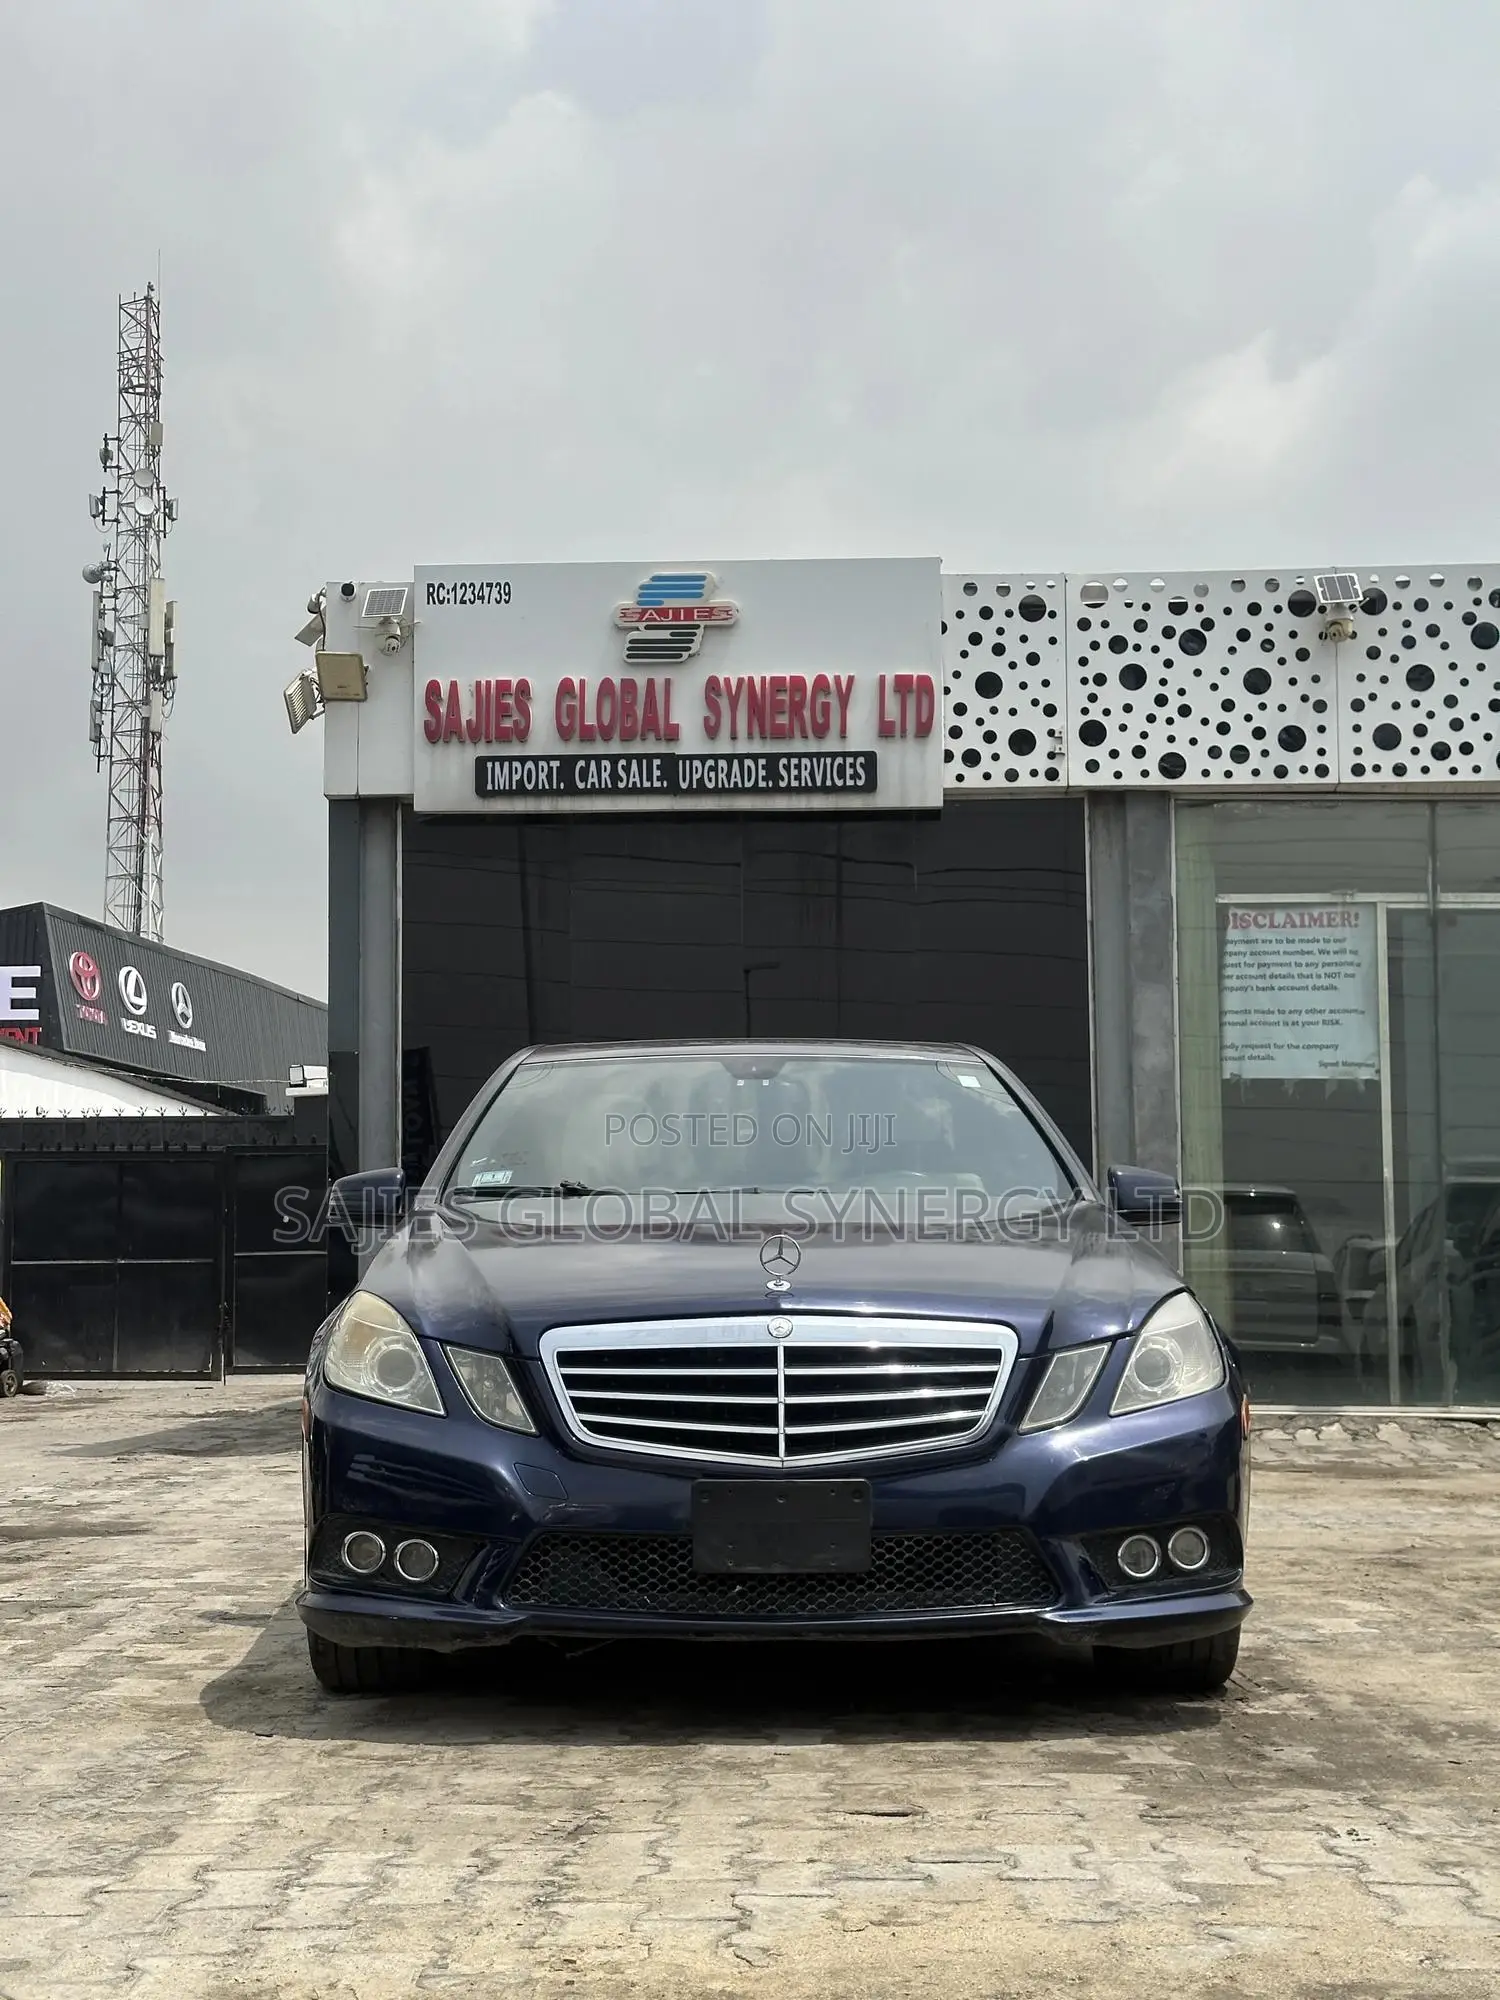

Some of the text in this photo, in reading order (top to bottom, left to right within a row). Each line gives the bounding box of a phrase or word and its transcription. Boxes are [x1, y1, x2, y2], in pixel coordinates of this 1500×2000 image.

[426, 582, 512, 605] RC:1234739
[619, 606, 734, 621] SAJIES
[424, 674, 935, 744] SAJIES GLOBAL SYNERGY LTD
[486, 756, 866, 790] IMPORT. CAR SALE. UPGRADE. SERVICES
